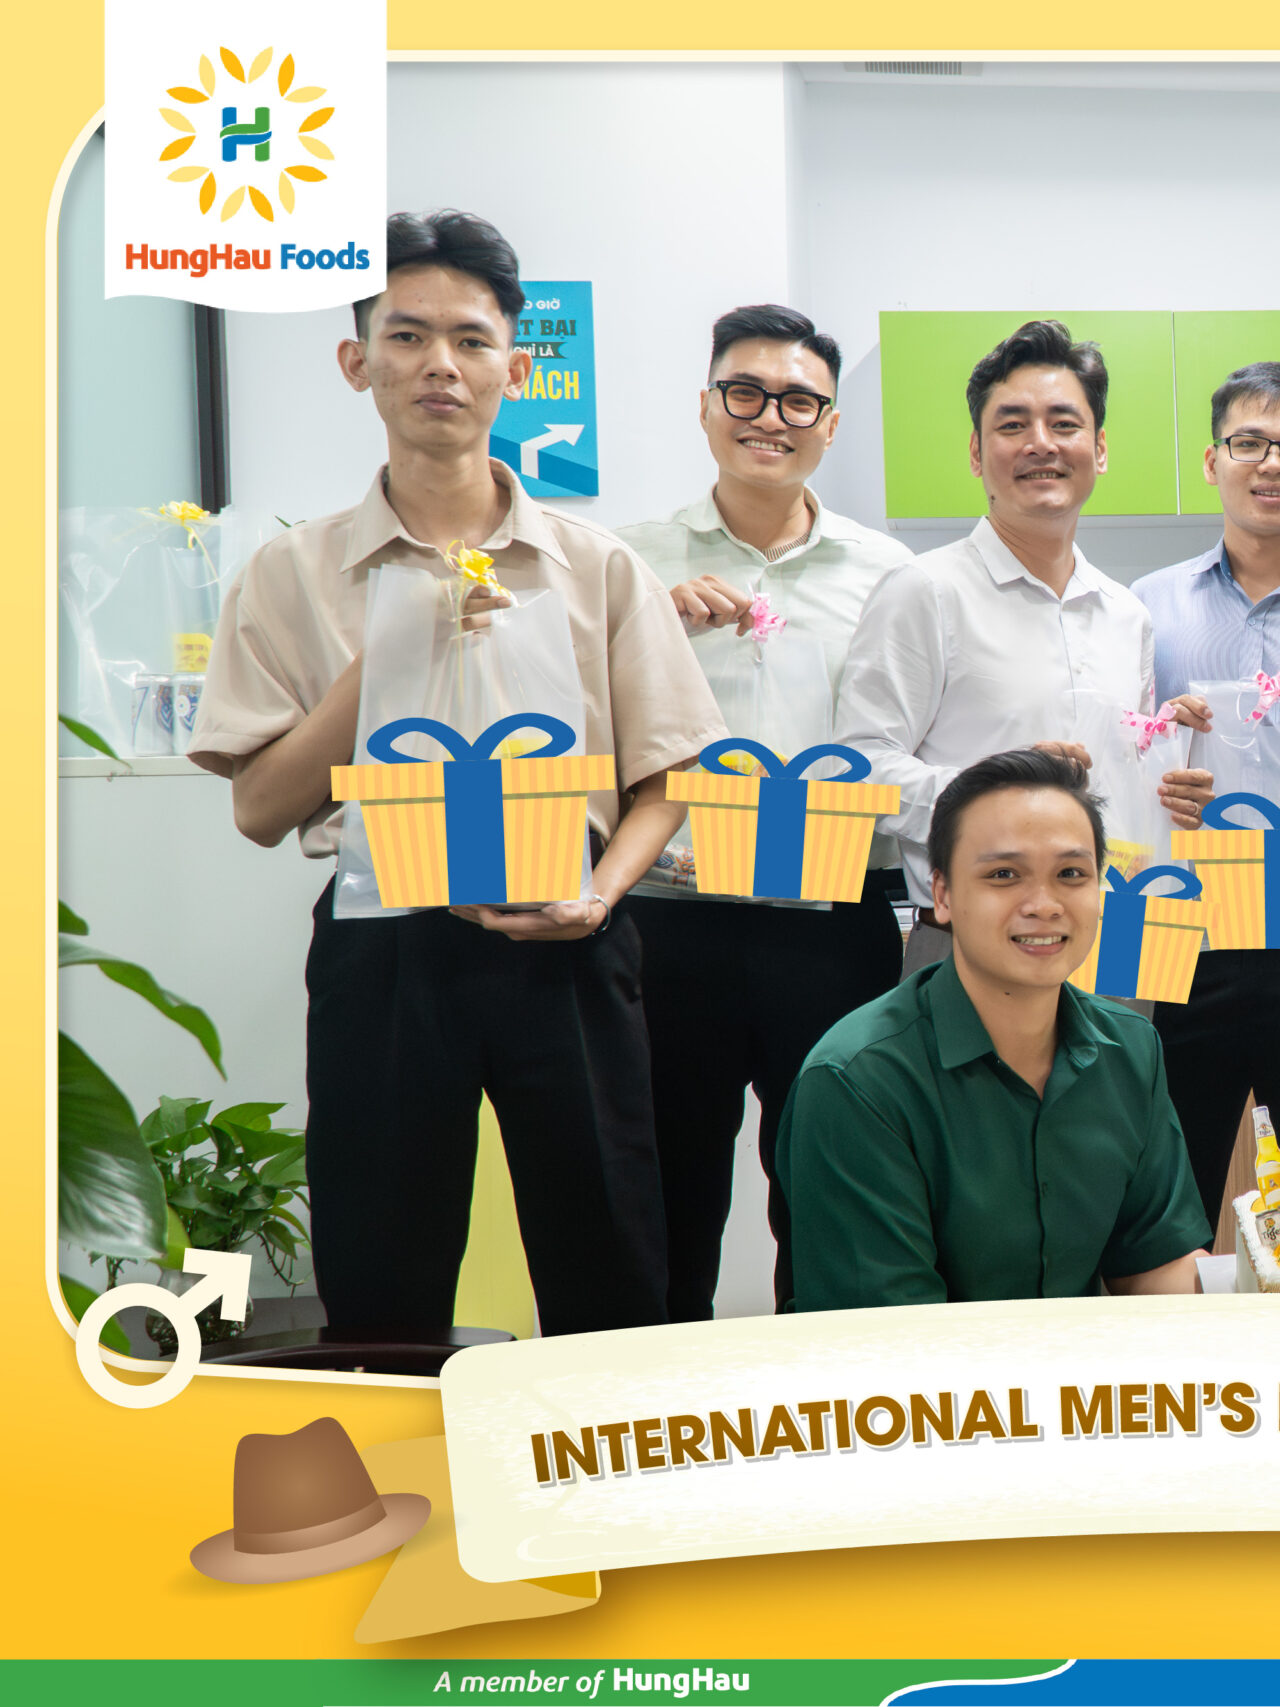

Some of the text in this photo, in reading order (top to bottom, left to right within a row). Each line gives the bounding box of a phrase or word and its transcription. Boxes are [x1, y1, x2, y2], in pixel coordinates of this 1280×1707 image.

[536, 298, 561, 310] GIỜ
[540, 319, 577, 339] BẠI
[539, 344, 554, 356] LÀ
